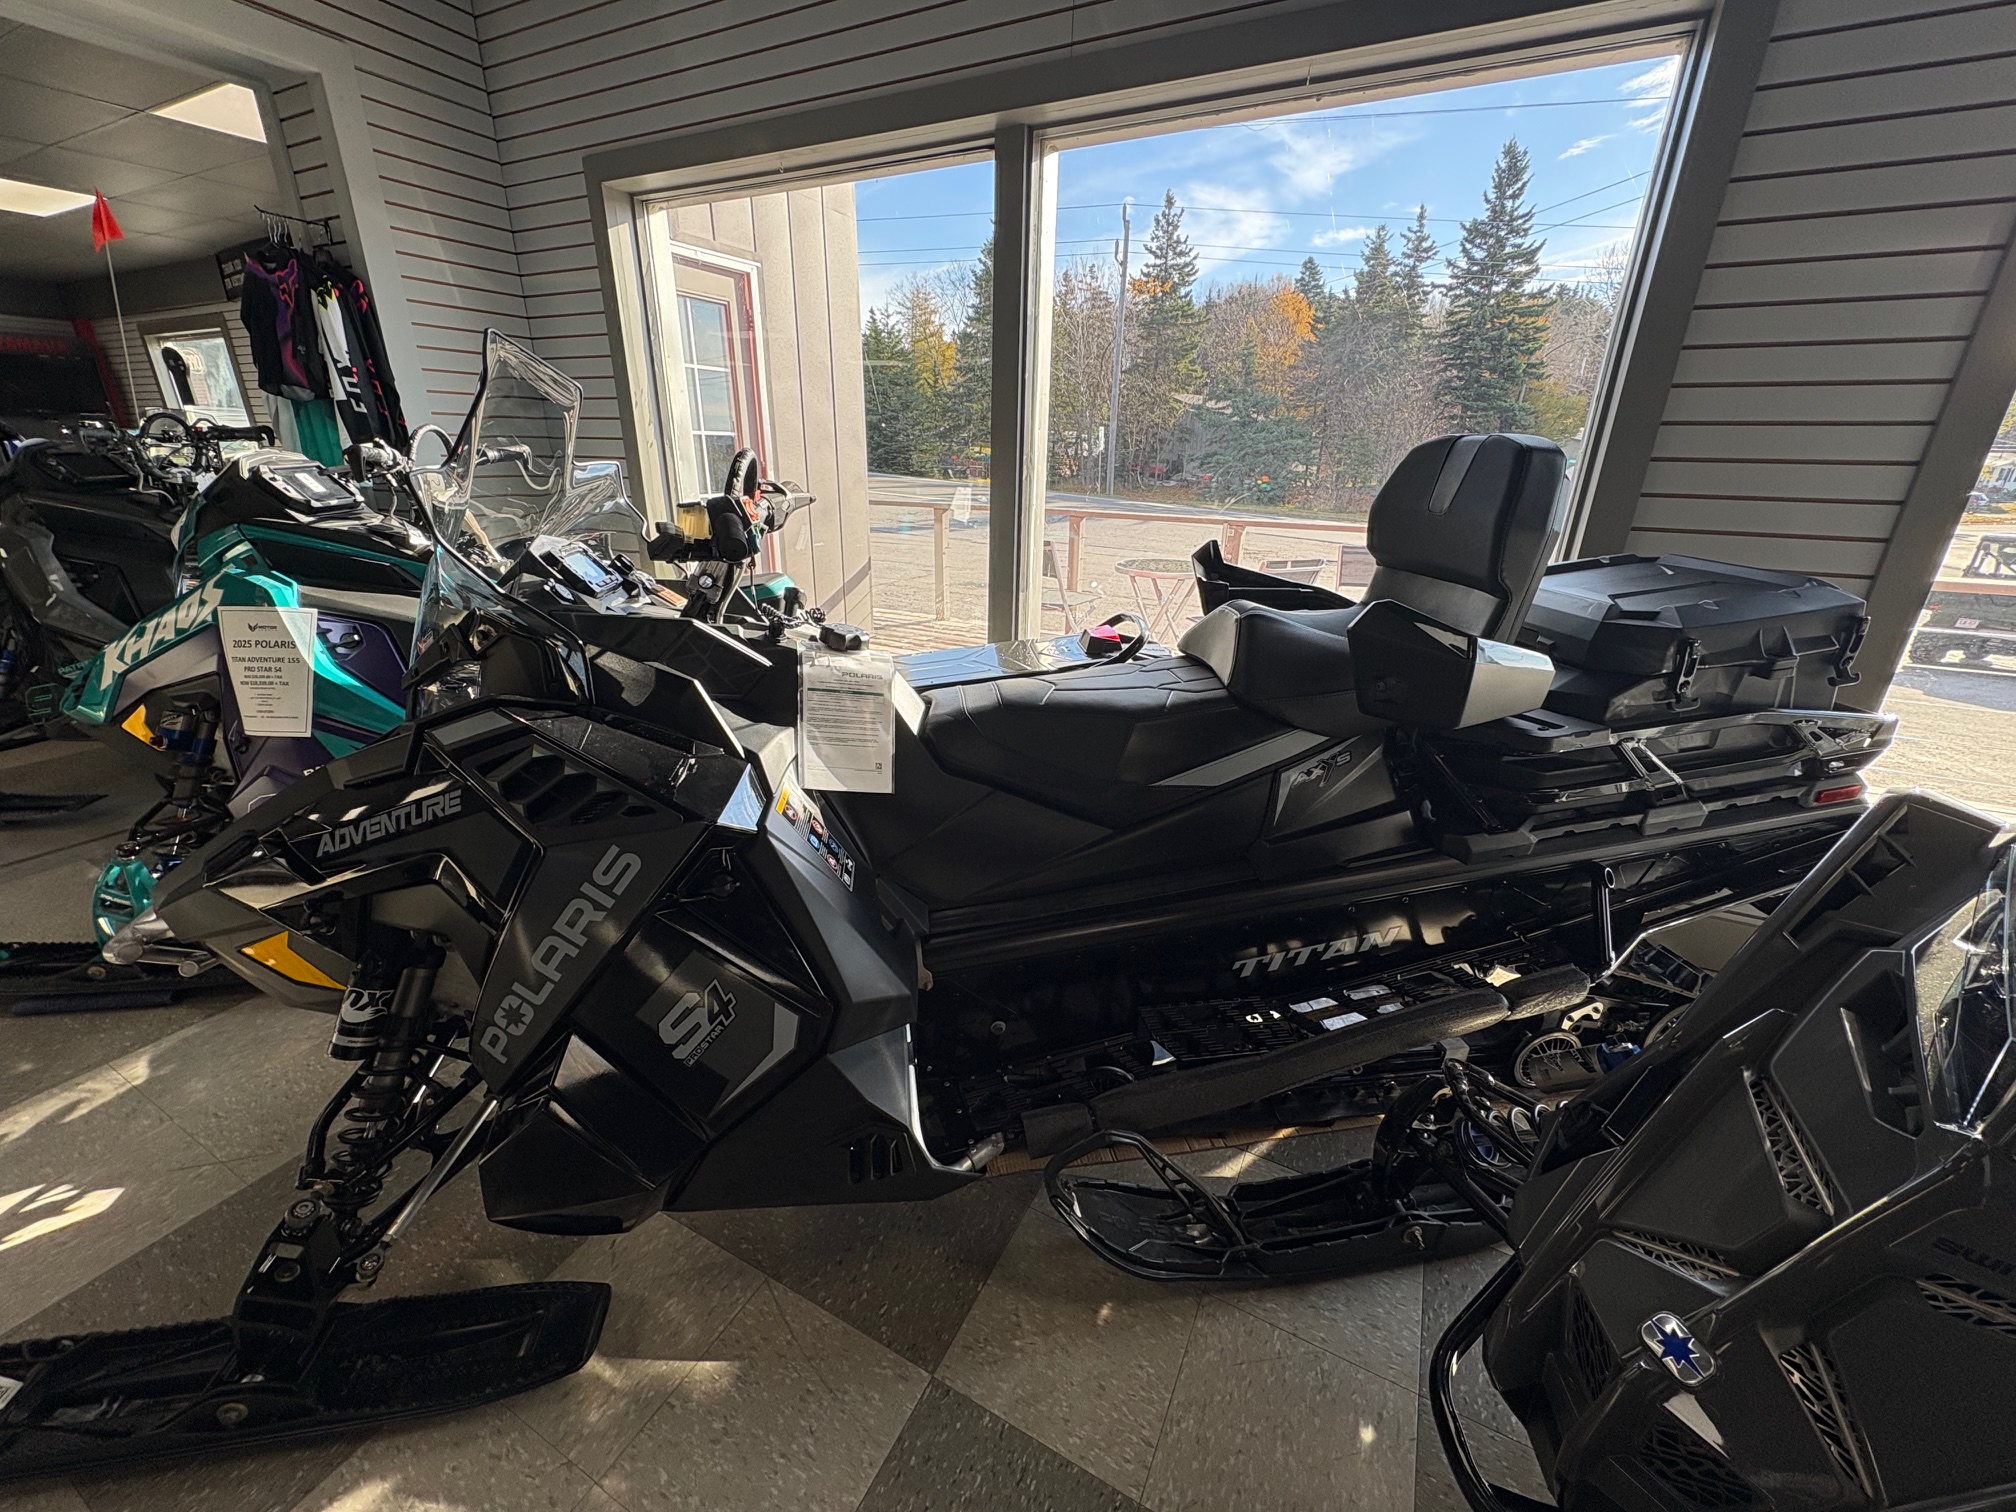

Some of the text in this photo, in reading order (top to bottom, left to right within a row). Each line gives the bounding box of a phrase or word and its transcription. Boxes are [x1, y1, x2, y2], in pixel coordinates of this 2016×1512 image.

[100, 567, 226, 691] KHAOS
[232, 639, 296, 649] 2025 POLARIS
[247, 656, 286, 664] ADVENTURE
[841, 671, 883, 680] POLARIS
[316, 788, 462, 858] ADVENTURE
[480, 844, 642, 1064] POLARIS
[1232, 925, 1402, 978] TITAN
[659, 979, 737, 1059] S4
[683, 1025, 725, 1067] PROSTAR
